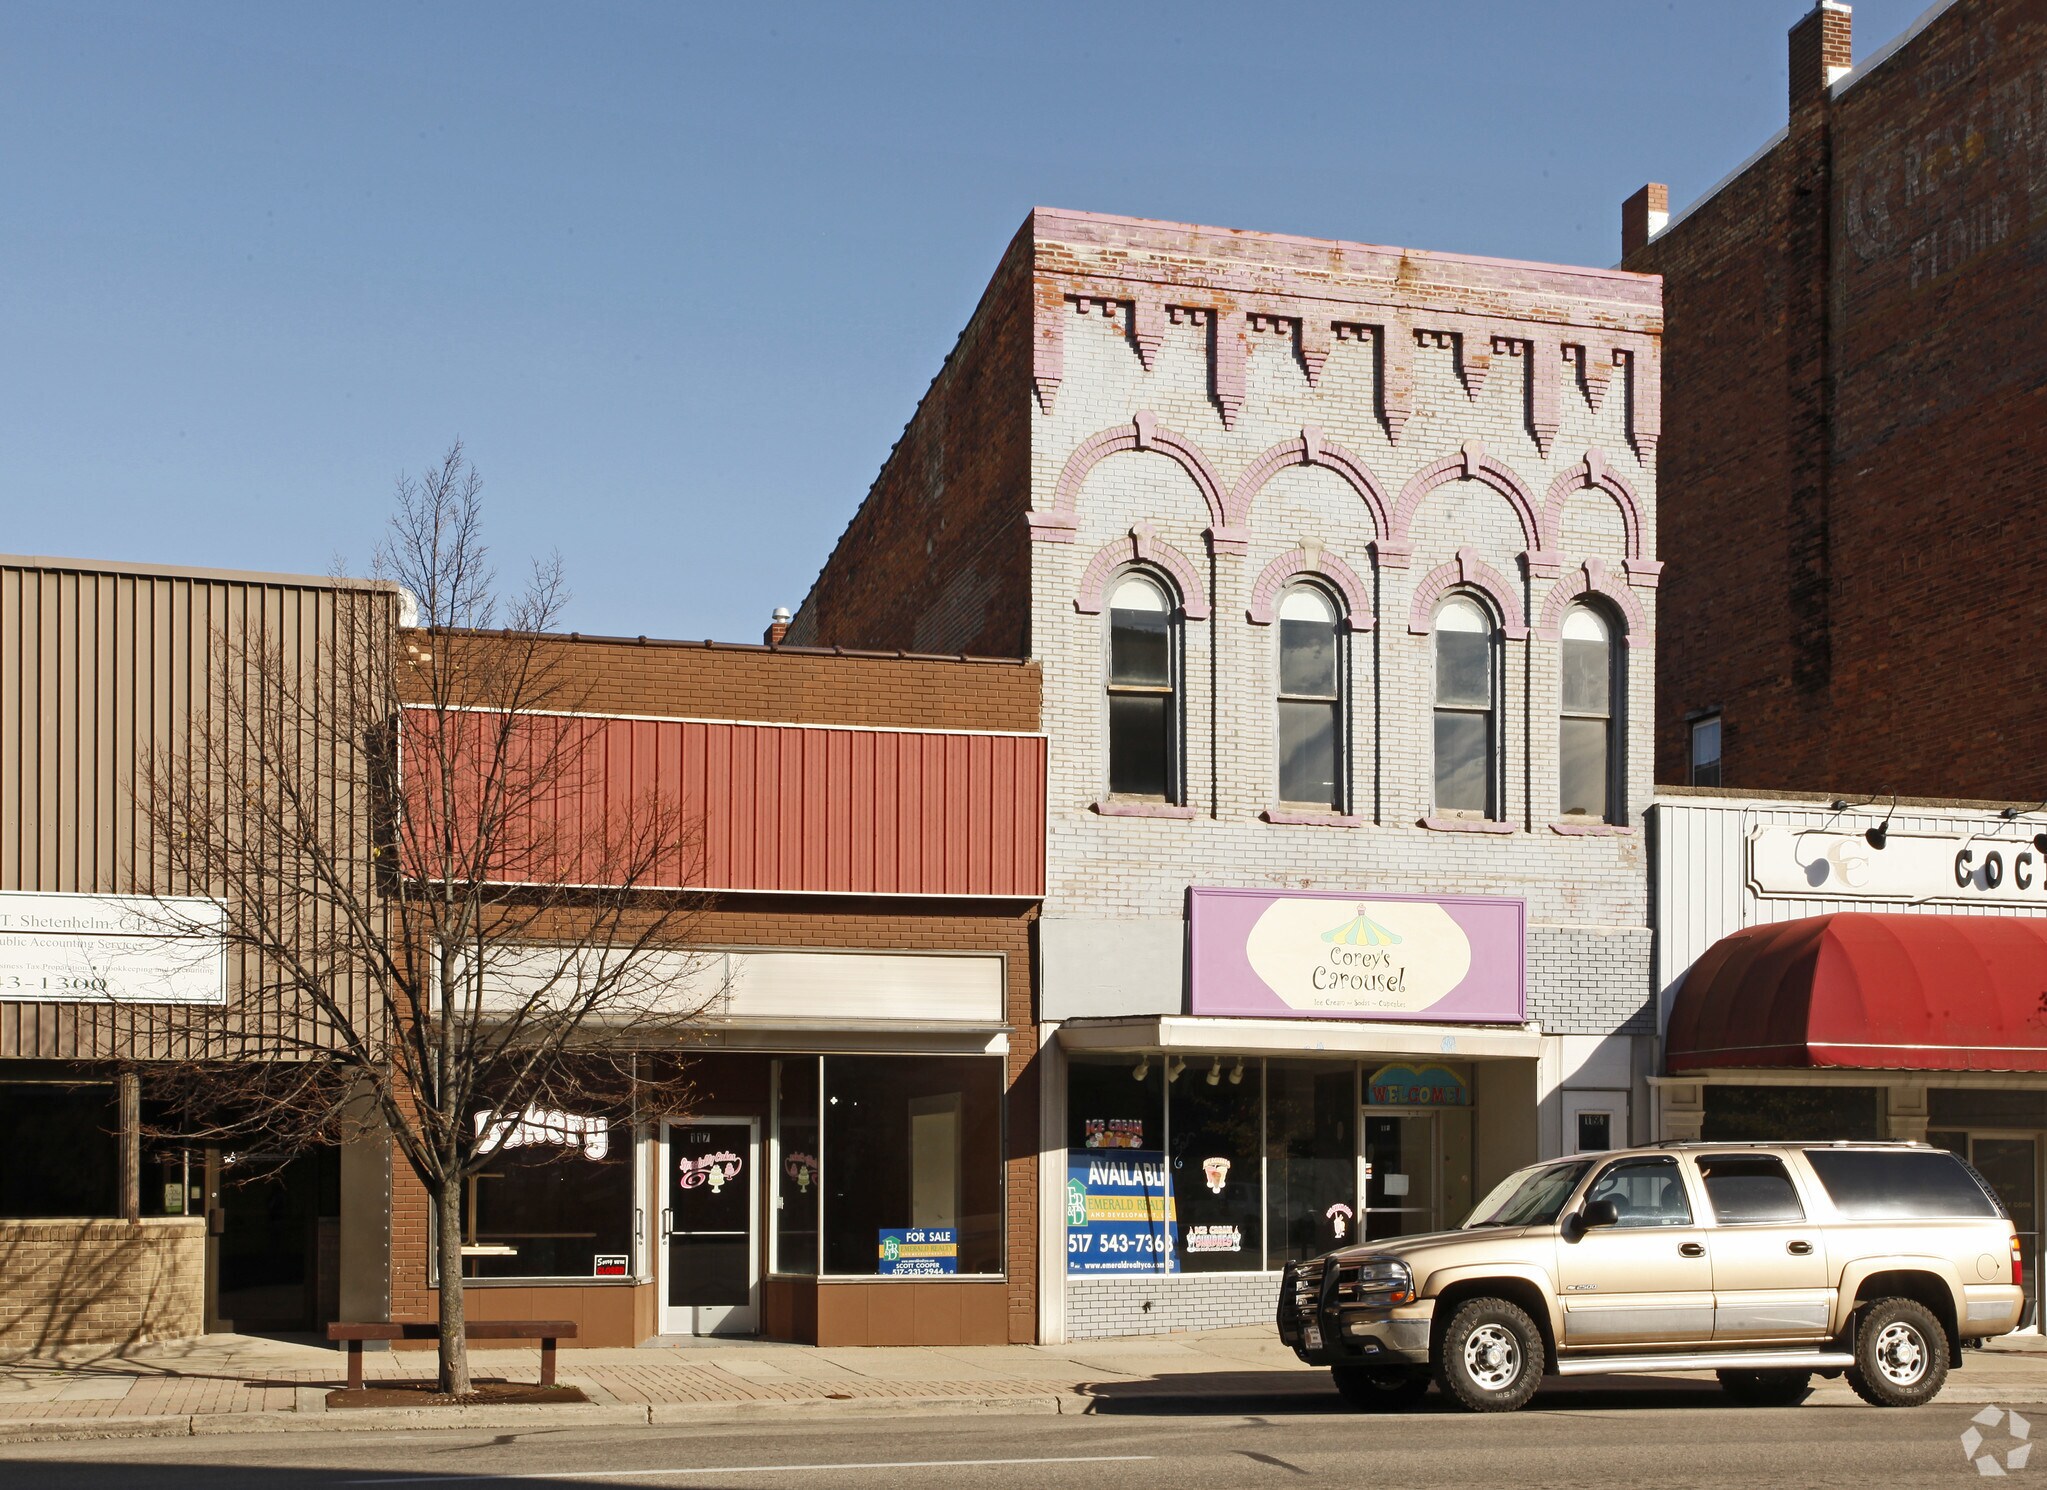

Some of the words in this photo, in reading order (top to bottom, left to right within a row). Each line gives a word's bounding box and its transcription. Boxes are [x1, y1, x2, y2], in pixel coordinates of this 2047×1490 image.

[1955, 849, 2047, 890] COC
[29, 937, 94, 951] Accounting
[97, 939, 144, 951] Services
[1330, 946, 1391, 970] Corey's
[26, 962, 40, 970] Tax
[42, 963, 88, 972] Preparation
[1312, 965, 1406, 993] Carousel
[1325, 998, 1345, 1006] Cream
[1372, 1085, 1461, 1105] WELCOME!
[473, 1101, 608, 1161] Bakery
[1085, 1119, 1105, 1137] ICE
[1108, 1119, 1143, 1137] CREAM
[690, 1132, 711, 1143] 117
[1088, 1198, 1134, 1210] EMERALD
[906, 1232, 925, 1243] FOR
[929, 1231, 951, 1242] SALE
[1068, 1234, 1093, 1253] 517
[900, 1245, 929, 1253] EMERALD
[931, 1244, 953, 1252] REALTY
[597, 1266, 625, 1275] CLOSED
